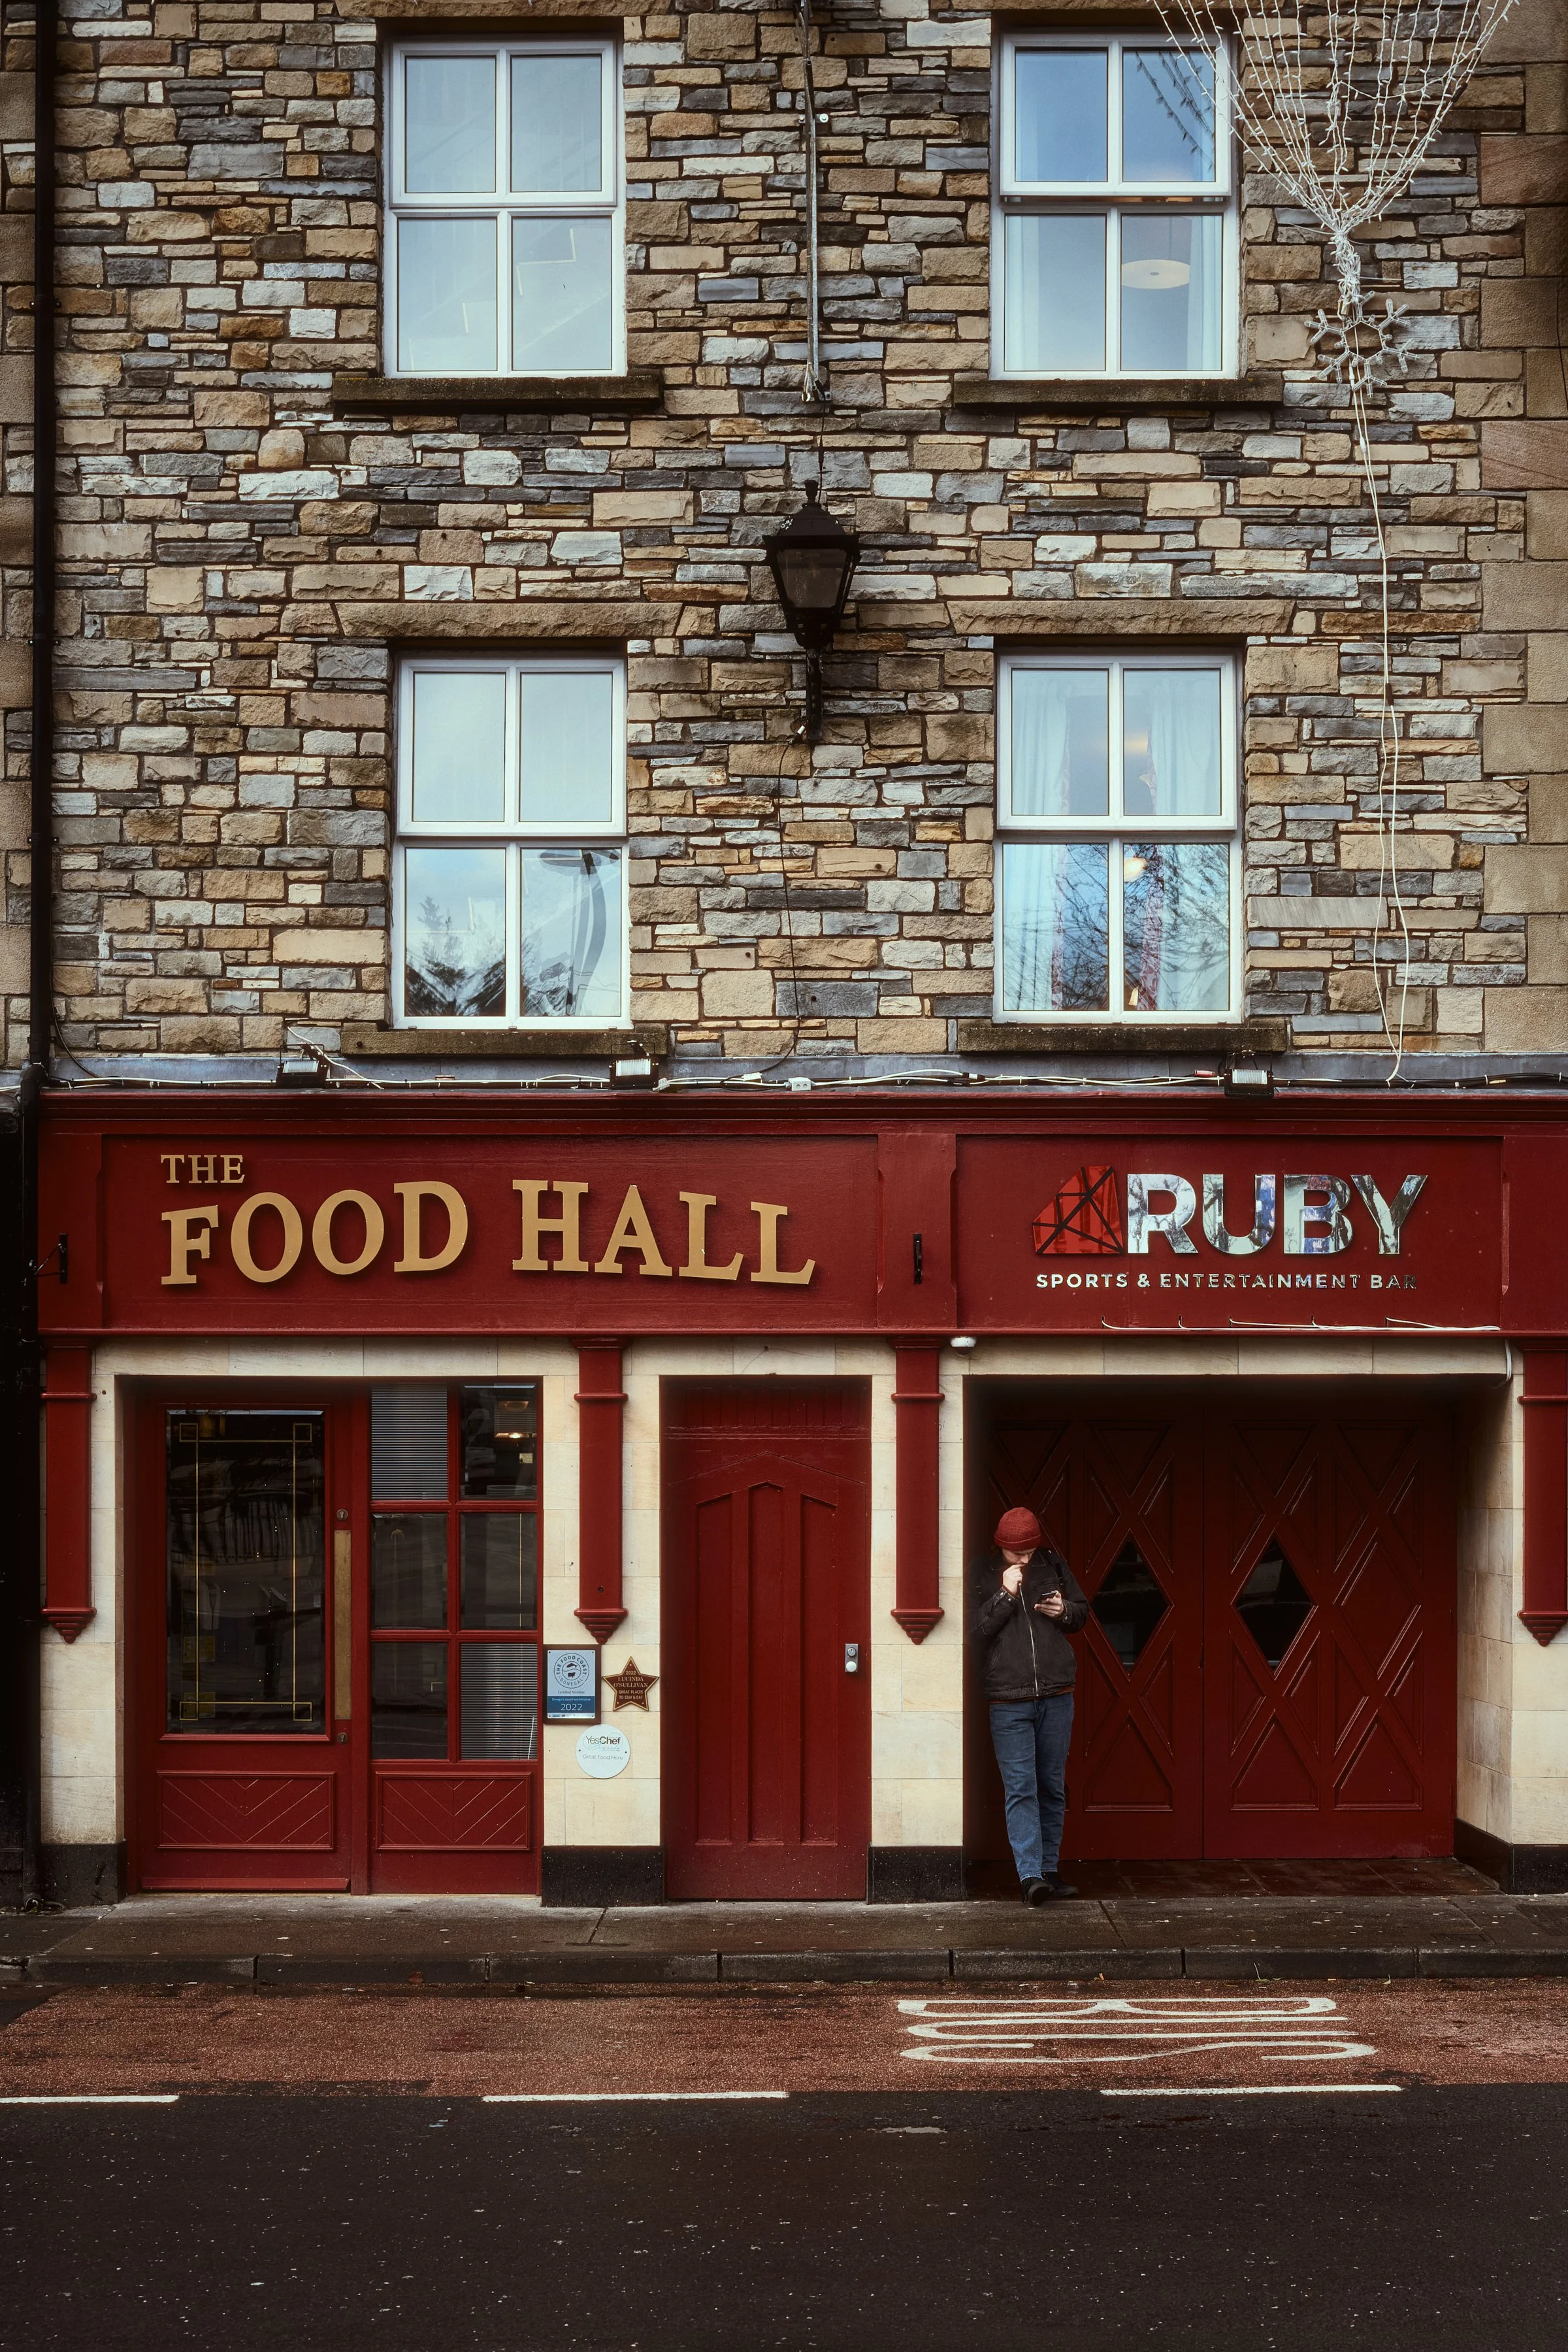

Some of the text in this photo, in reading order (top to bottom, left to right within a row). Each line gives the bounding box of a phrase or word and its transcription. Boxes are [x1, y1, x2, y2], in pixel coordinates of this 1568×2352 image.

[161, 1154, 245, 1184] THE
[1127, 1174, 1428, 1255] RUBY
[161, 1180, 815, 1285] FOOD HALL
[1036, 1273, 1417, 1289] SPORTS & ENTERTAINMENT BAR
[577, 1657, 587, 1675] COAST
[560, 1678, 583, 1686] DONEGAL
[585, 1735, 621, 1745] YesChef
[898, 1997, 1377, 2062] BUS
